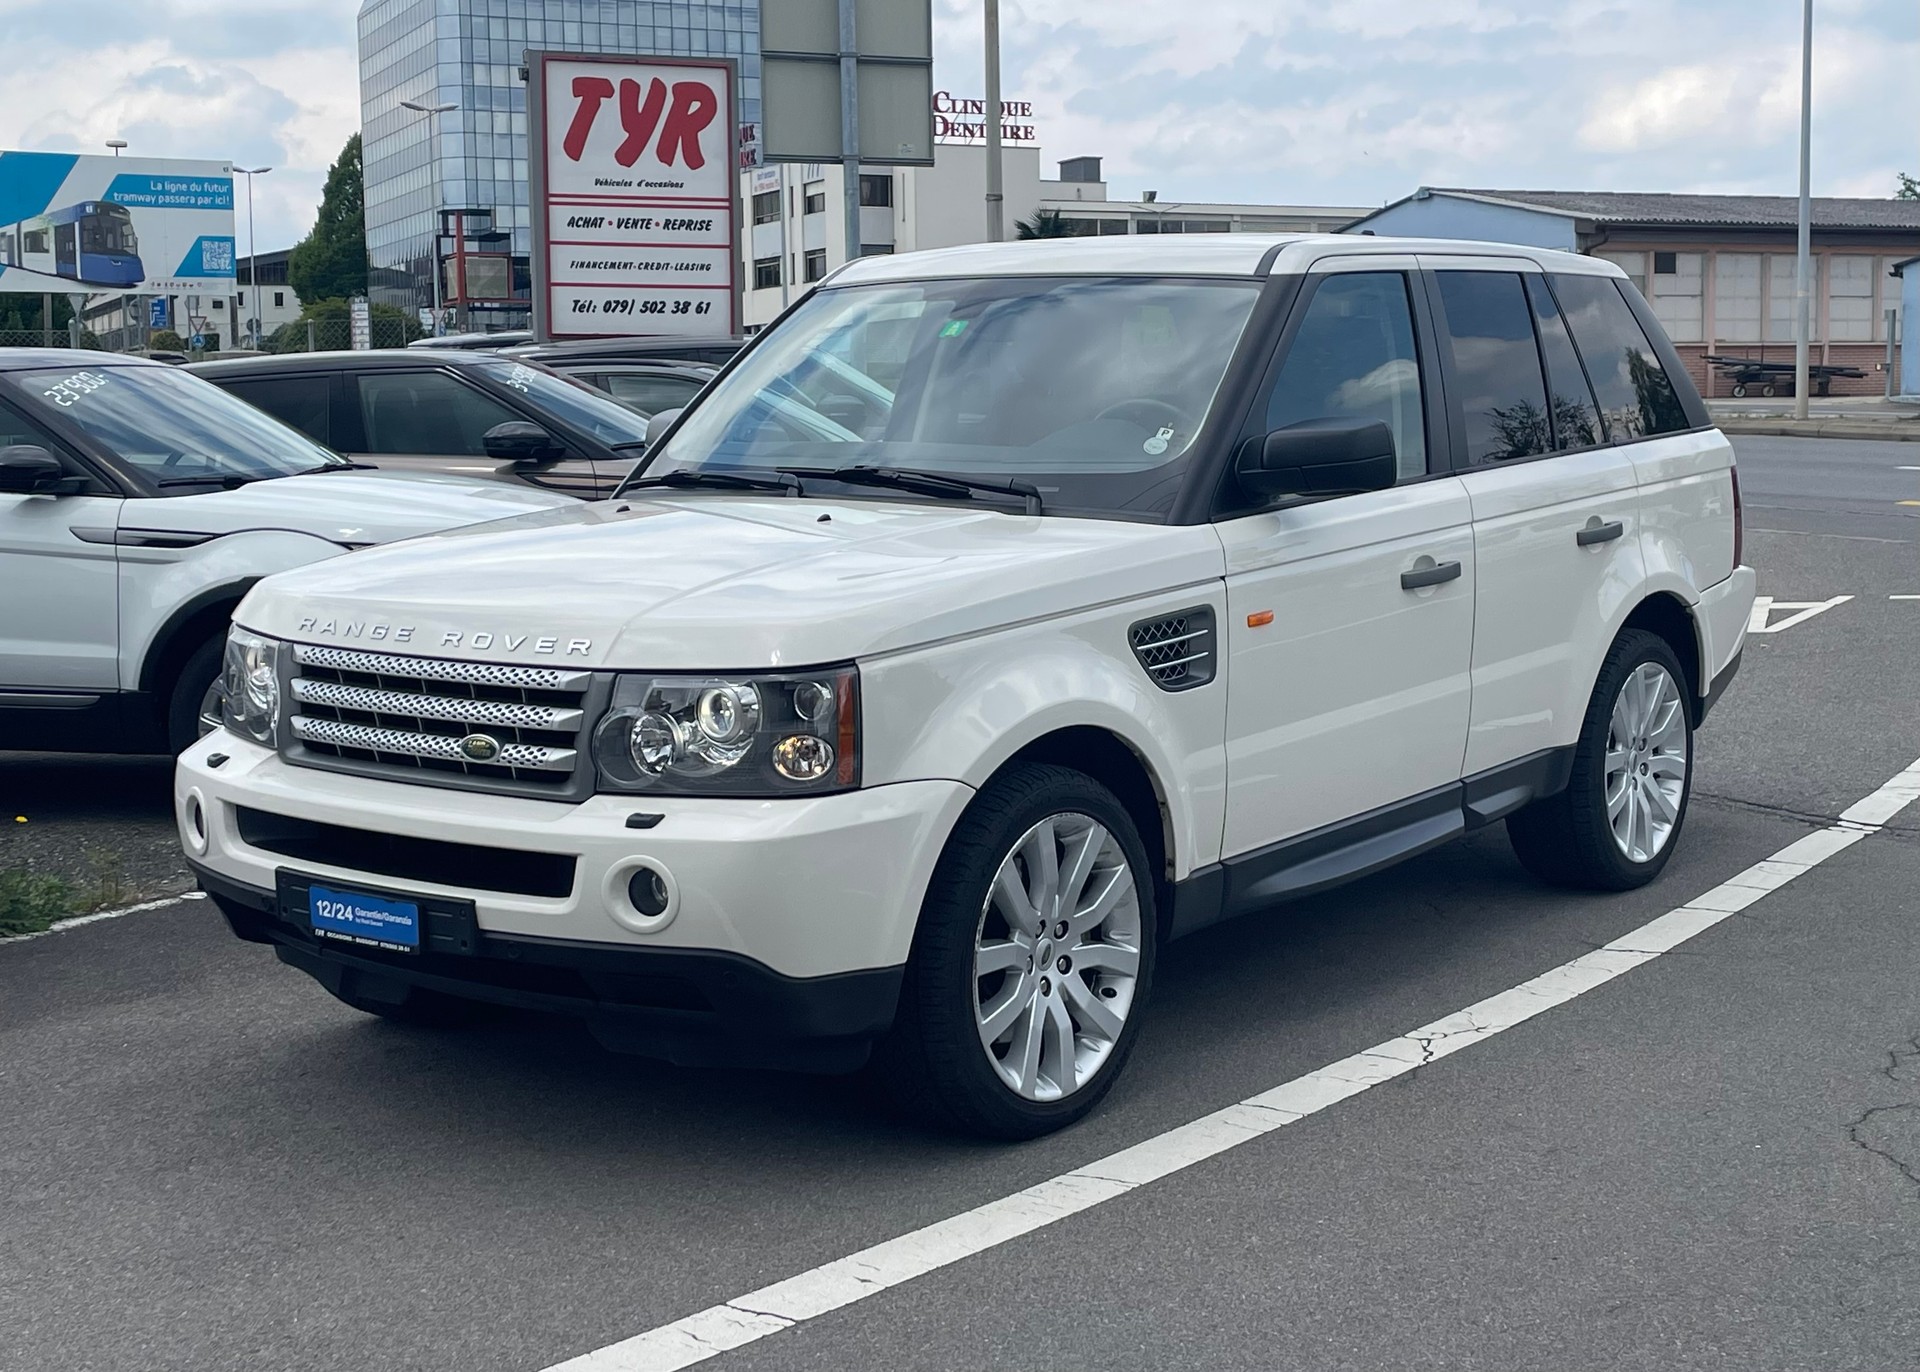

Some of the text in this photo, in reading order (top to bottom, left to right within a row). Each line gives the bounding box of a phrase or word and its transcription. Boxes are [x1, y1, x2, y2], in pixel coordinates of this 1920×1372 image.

[933, 91, 1032, 119] CLINUE
[563, 76, 718, 170] TYR
[933, 114, 1035, 140] DENTIRE
[150, 181, 229, 193] La ligne du futur
[594, 177, 684, 189] Véhicules d'occasions
[113, 192, 156, 204] tramway
[158, 194, 195, 204] passera
[197, 195, 213, 205] par
[567, 216, 713, 231] ACHAT VENTE REPRISE
[570, 260, 712, 271] FINANCEMENT CREDIT LEASING
[571, 299, 597, 313] Tél:
[639, 300, 667, 314] 502
[671, 300, 692, 314] 38
[695, 301, 711, 315] 61
[298, 616, 593, 656] RANGE ROVER
[316, 899, 353, 921] 12/24
